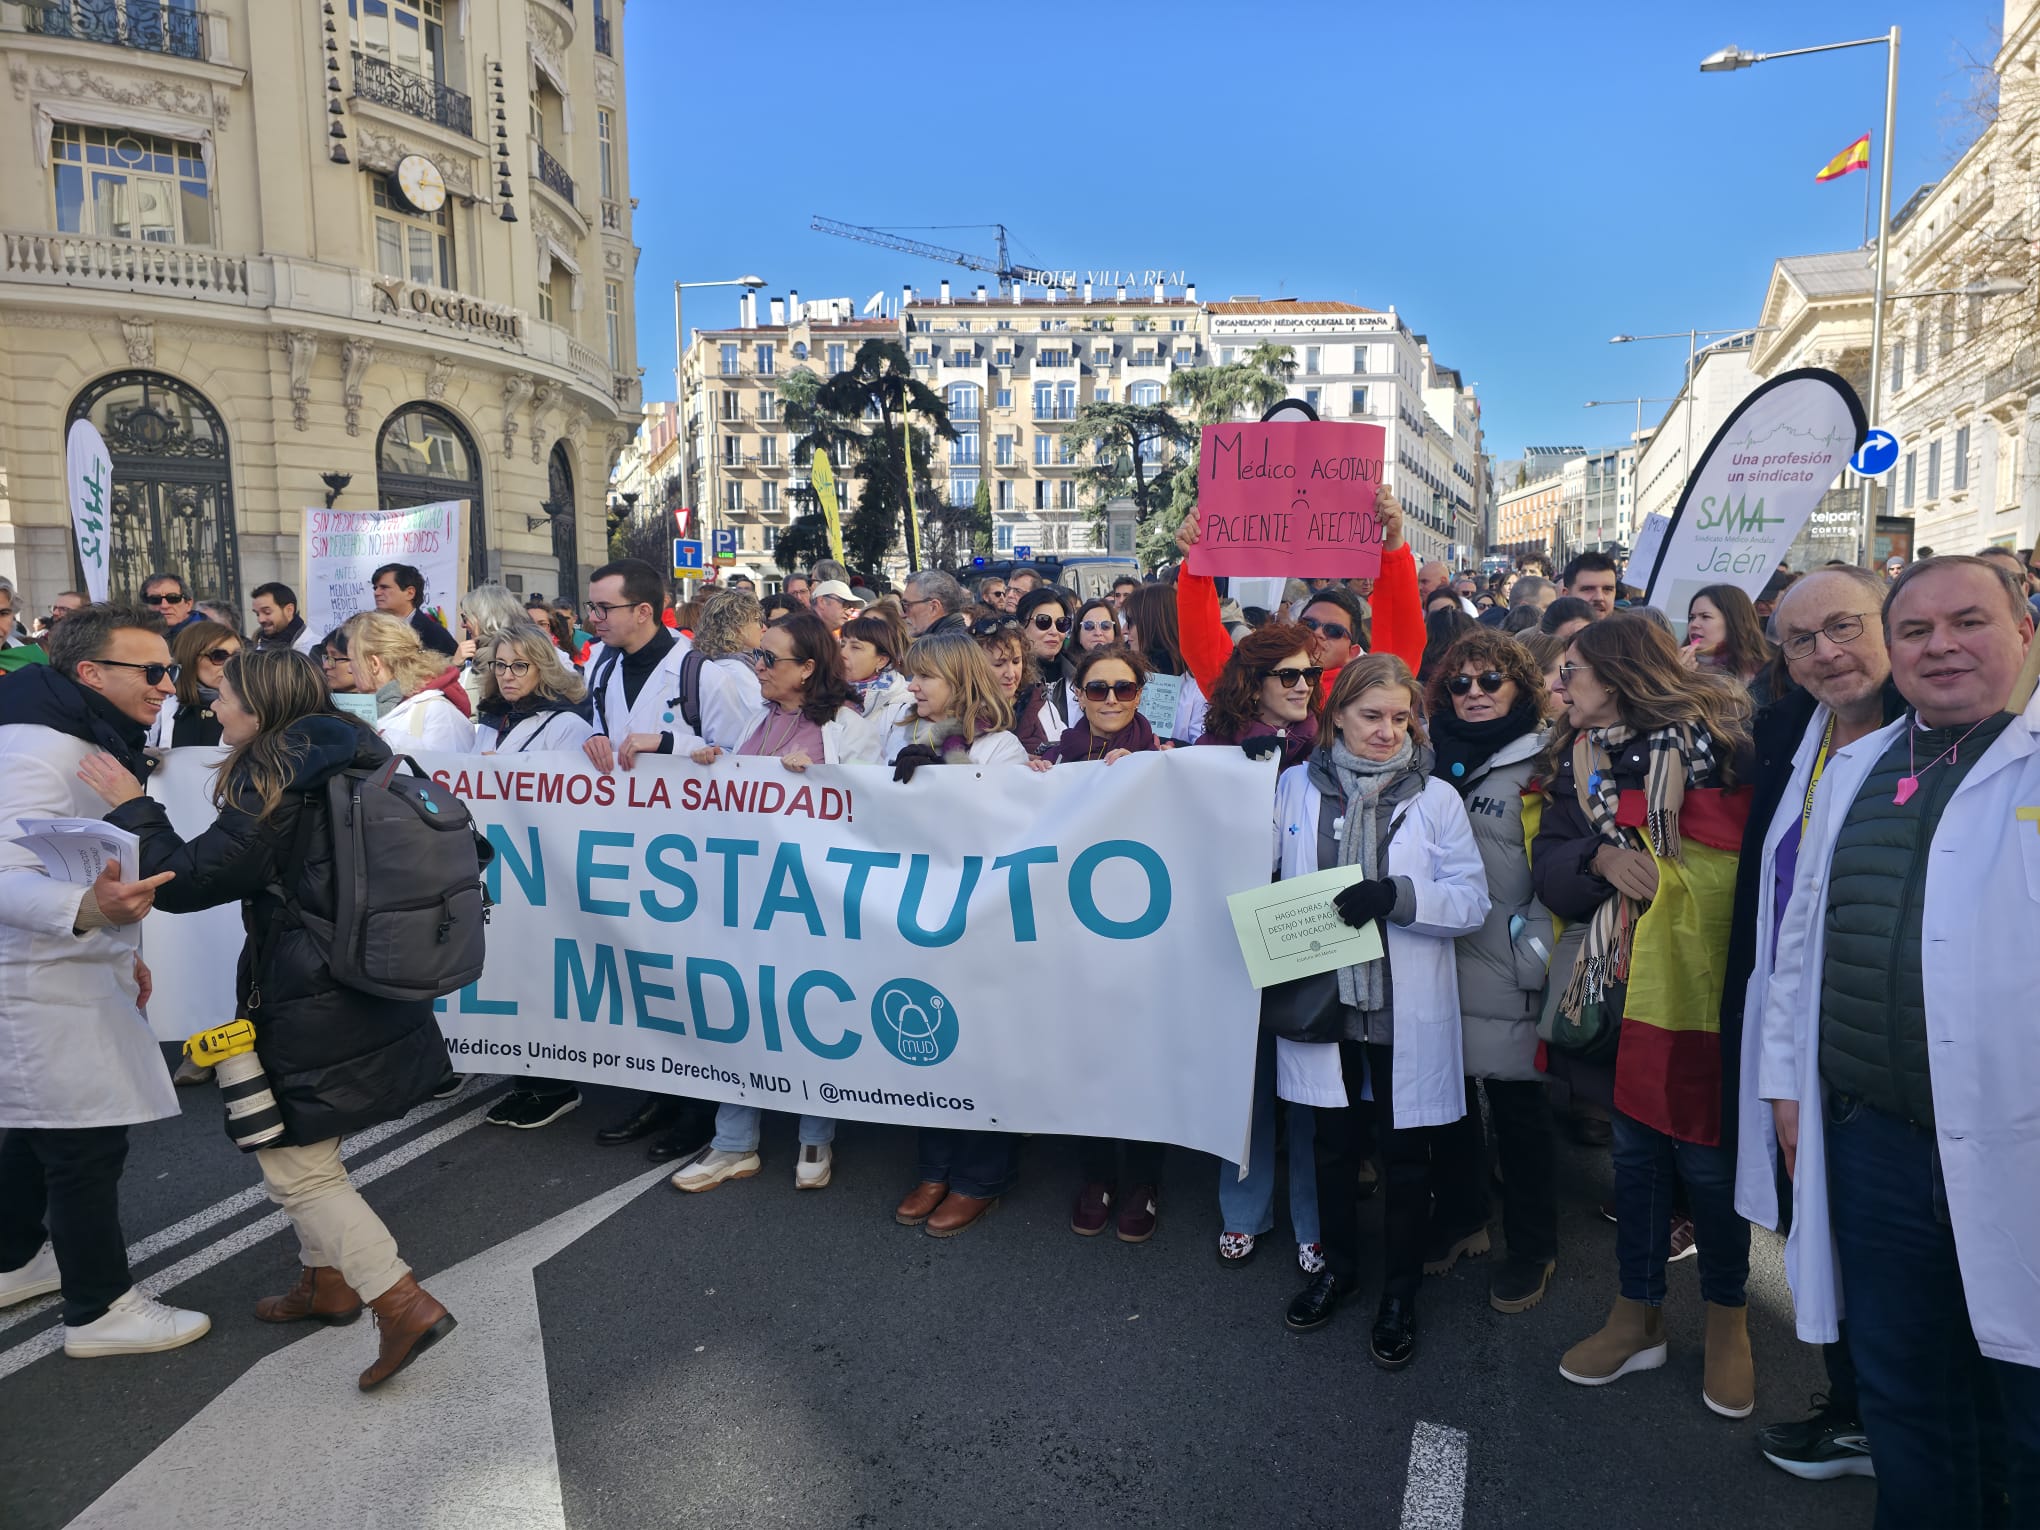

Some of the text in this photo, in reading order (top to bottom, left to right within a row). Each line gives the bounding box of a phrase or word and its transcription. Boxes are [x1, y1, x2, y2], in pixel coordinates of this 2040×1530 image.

[1028, 270, 1188, 287] HOTEL VILLA REAL
[411, 289, 522, 337] Occident
[1305, 317, 1344, 327] COLEGIAL
[1346, 317, 1357, 326] DE
[1359, 316, 1388, 326] ESPAÑA
[1212, 431, 1383, 485] Médico AGOTADO
[1732, 451, 1833, 468] Una profesión
[1727, 469, 1814, 482] un sindicato
[1696, 493, 1785, 535] SMA
[1307, 511, 1384, 544] AFECTADO
[716, 531, 732, 552] P
[1696, 545, 1766, 574] Jaén
[432, 769, 853, 823] SALVEMOS LA SANIDAD!
[1470, 796, 1506, 818] HH
[576, 829, 1173, 948] ESTATUTO
[1275, 900, 1330, 921] HAGO HORAS A
[1268, 920, 1298, 936] DESTAJO
[1304, 915, 1316, 925] ME
[1280, 920, 1338, 943] CON VOCACIÓN
[445, 1037, 522, 1057] Médicos
[528, 1041, 587, 1063] Unidos
[593, 1052, 620, 1069] por
[626, 1054, 656, 1072] sus
[661, 1056, 746, 1089] Derechos,
[750, 1072, 792, 1094] MUD
[819, 1082, 976, 1112] @mudmedicos
